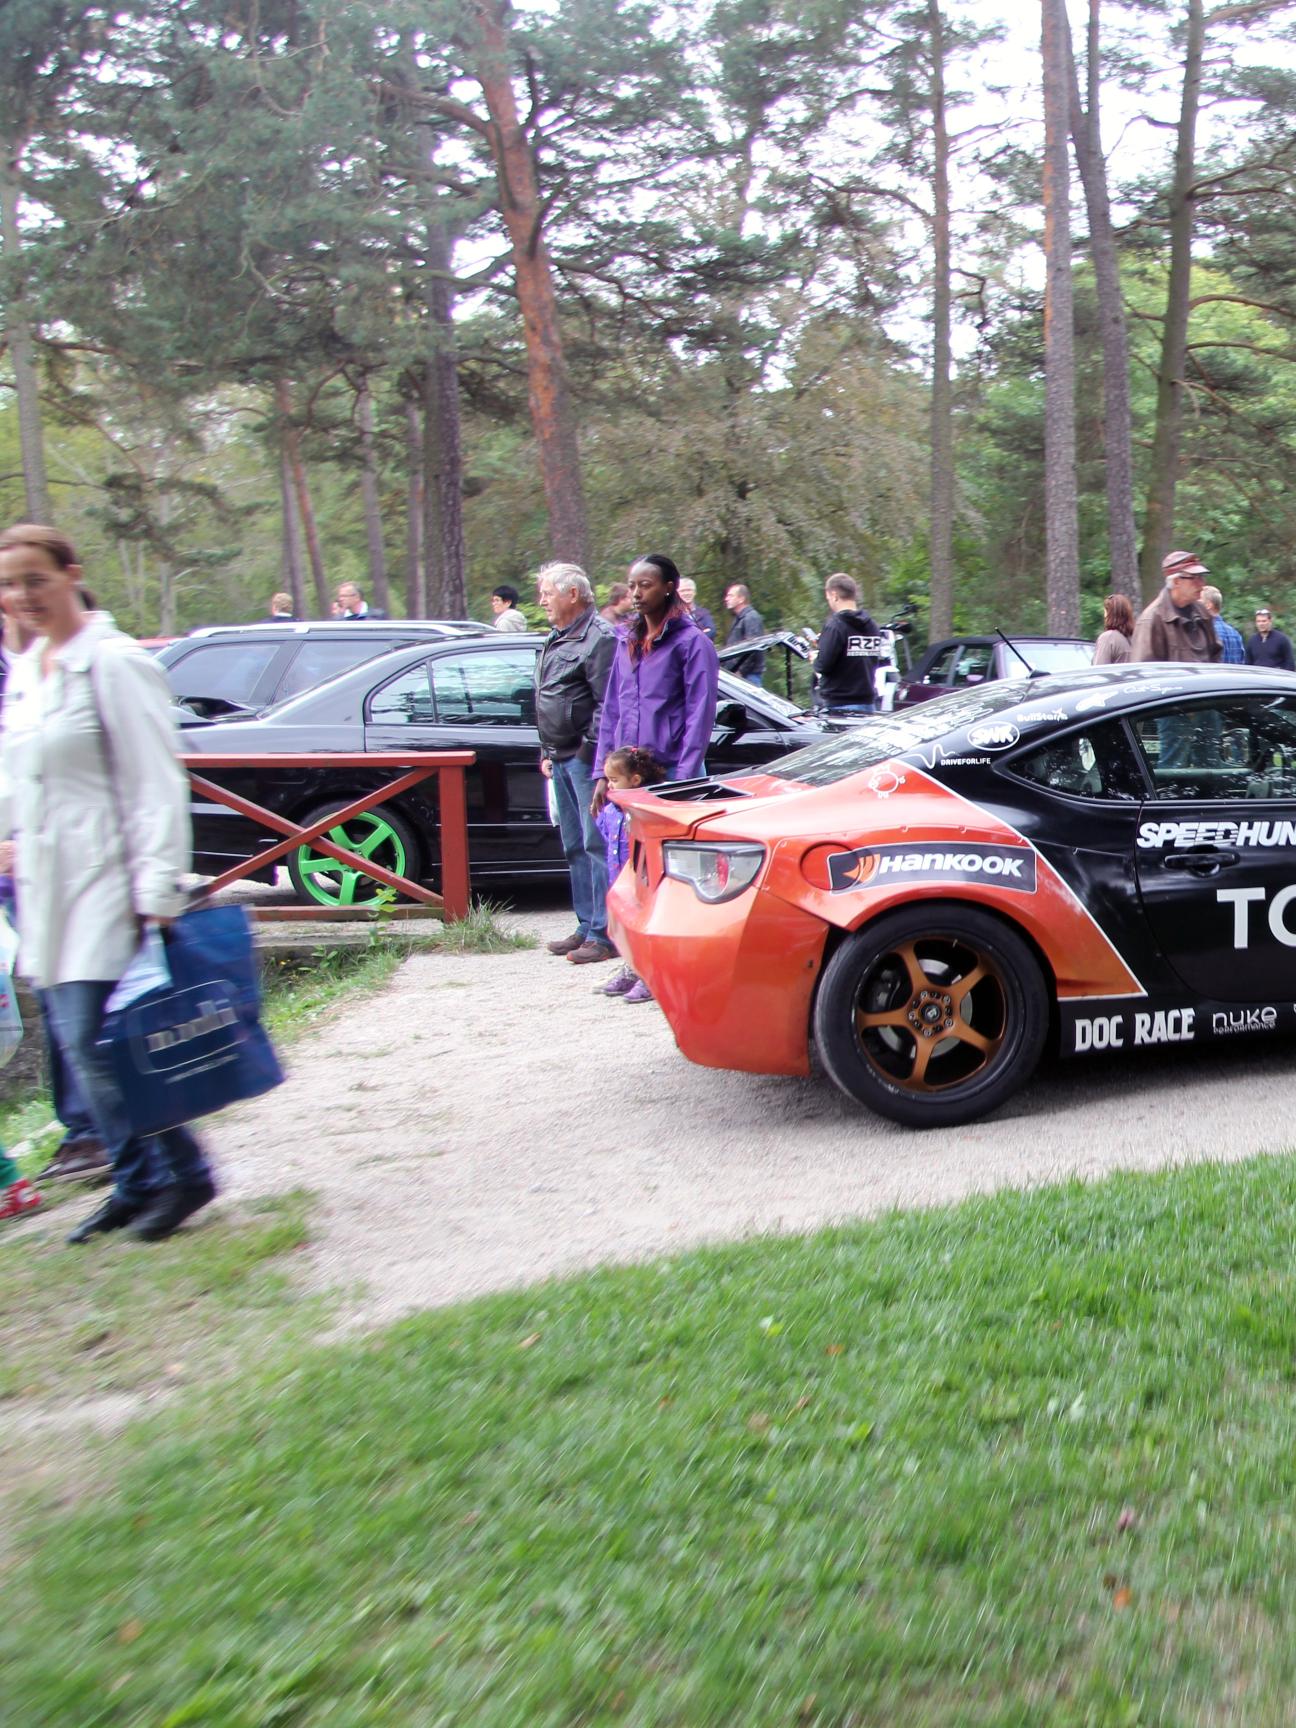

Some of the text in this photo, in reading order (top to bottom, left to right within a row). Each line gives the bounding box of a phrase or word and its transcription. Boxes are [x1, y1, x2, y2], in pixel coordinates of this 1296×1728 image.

[940, 757, 991, 766] DRIVEFORLIFE
[1212, 1006, 1278, 1027] nuke
[1075, 1007, 1196, 1052] DOC RACE
